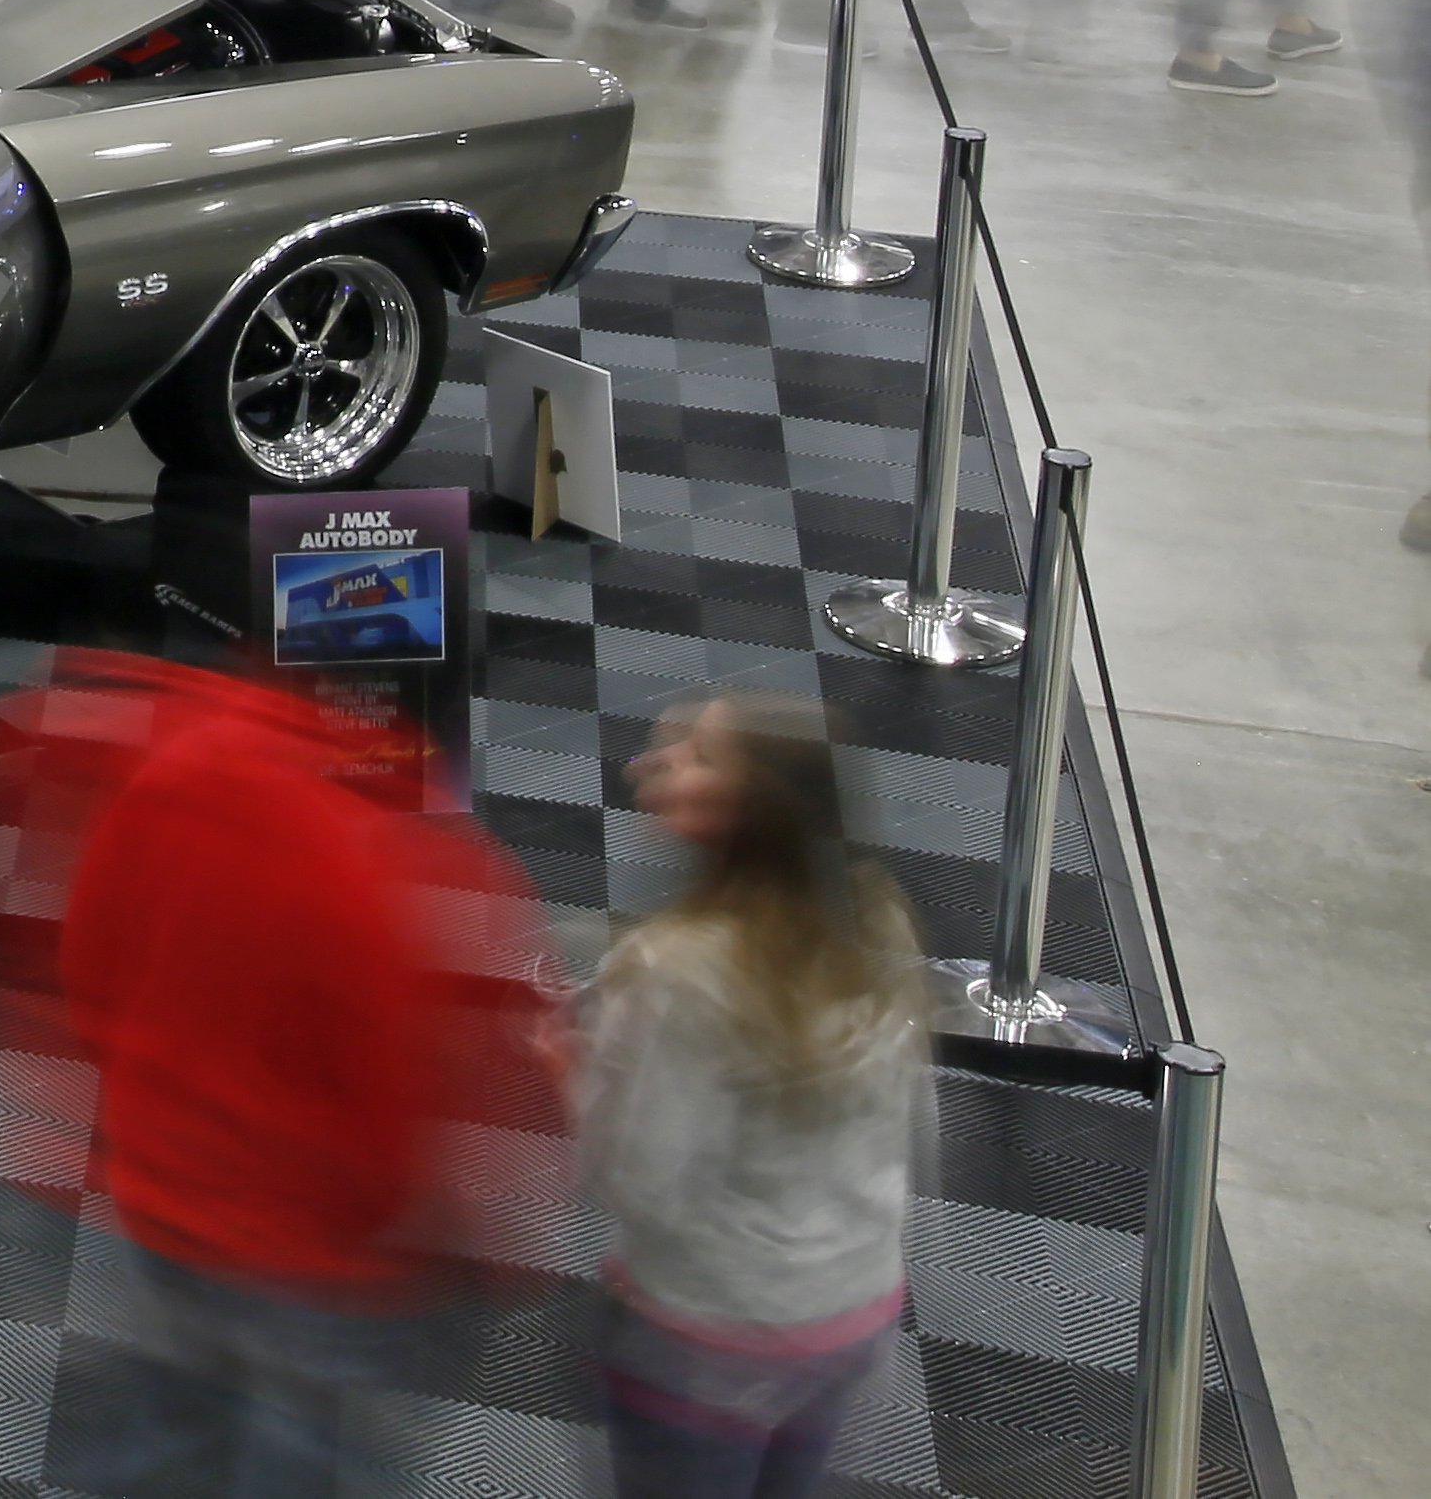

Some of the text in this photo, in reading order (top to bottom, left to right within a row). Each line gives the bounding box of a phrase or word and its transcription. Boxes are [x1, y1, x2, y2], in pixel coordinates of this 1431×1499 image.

[116, 272, 170, 301] SS
[325, 510, 392, 530] J MAX
[299, 528, 418, 550] AUTOBODY
